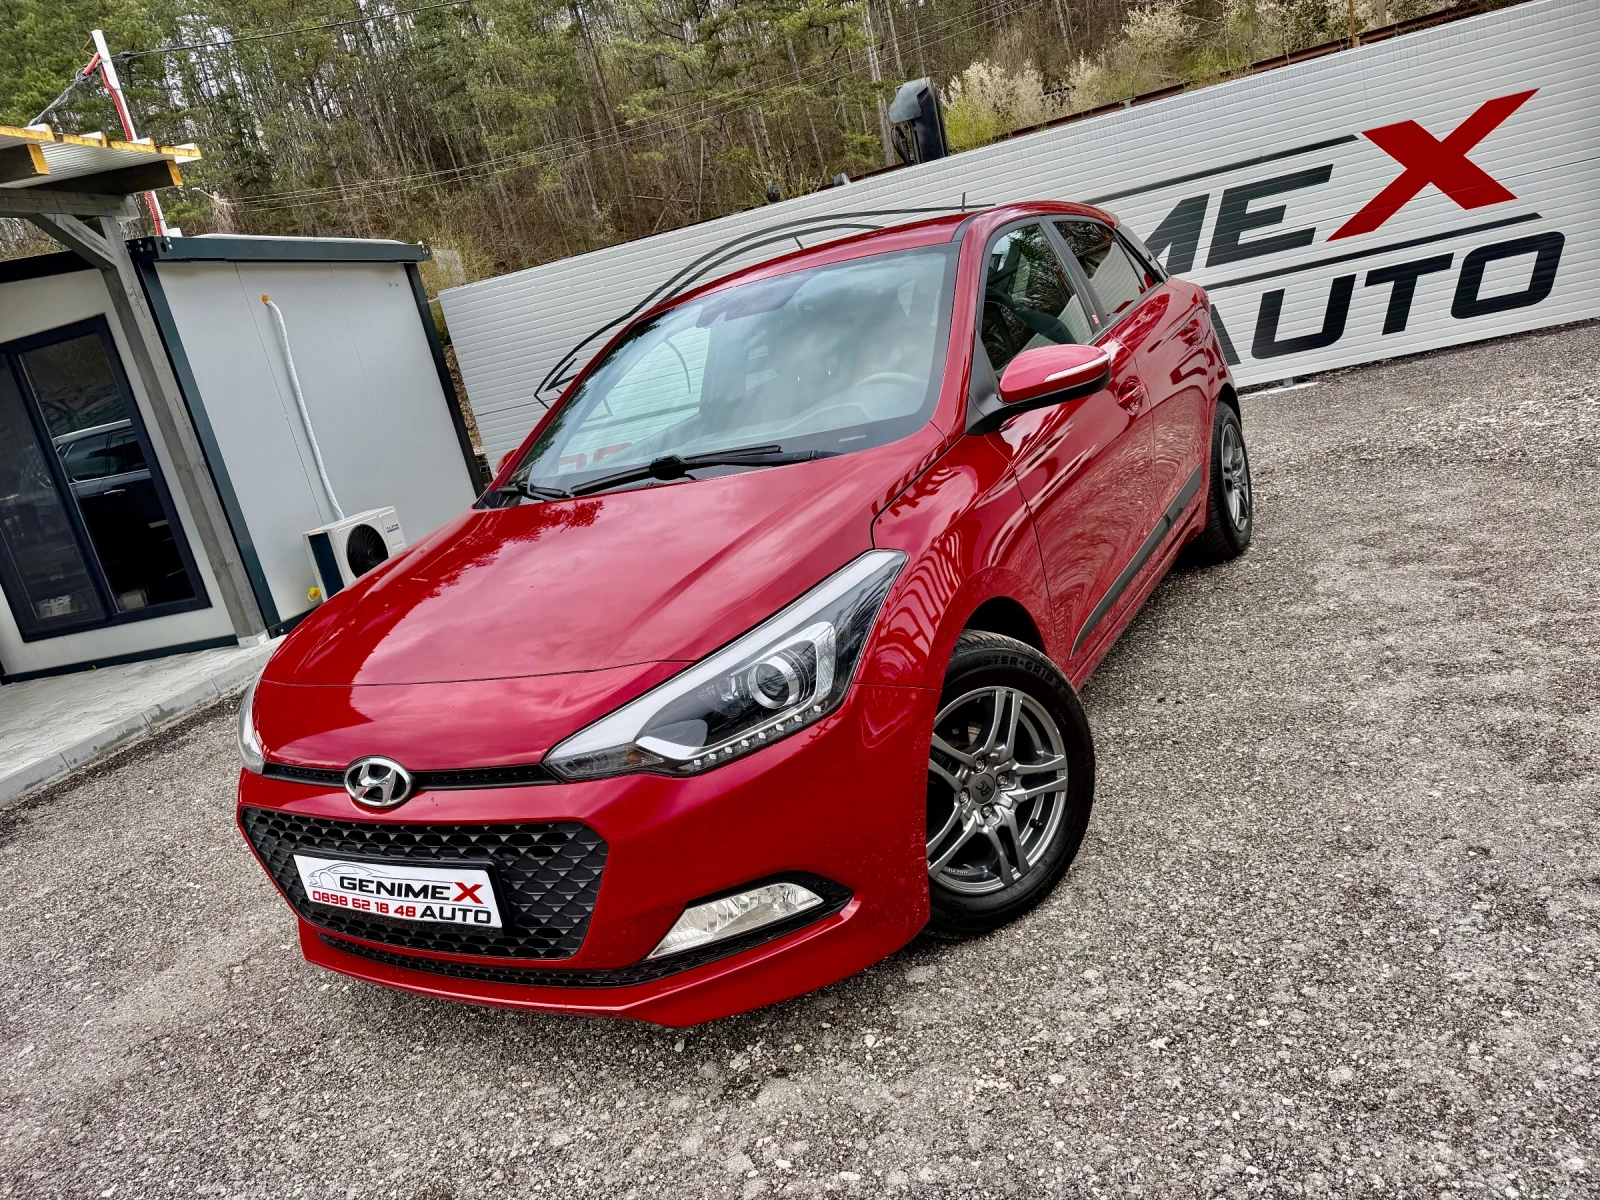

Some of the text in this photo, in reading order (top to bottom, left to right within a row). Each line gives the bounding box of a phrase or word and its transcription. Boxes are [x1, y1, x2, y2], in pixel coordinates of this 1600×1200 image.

[312, 890, 417, 918] 0898 62 18 48
[340, 876, 484, 905] GENIMEX
[419, 905, 492, 924] AUTO
